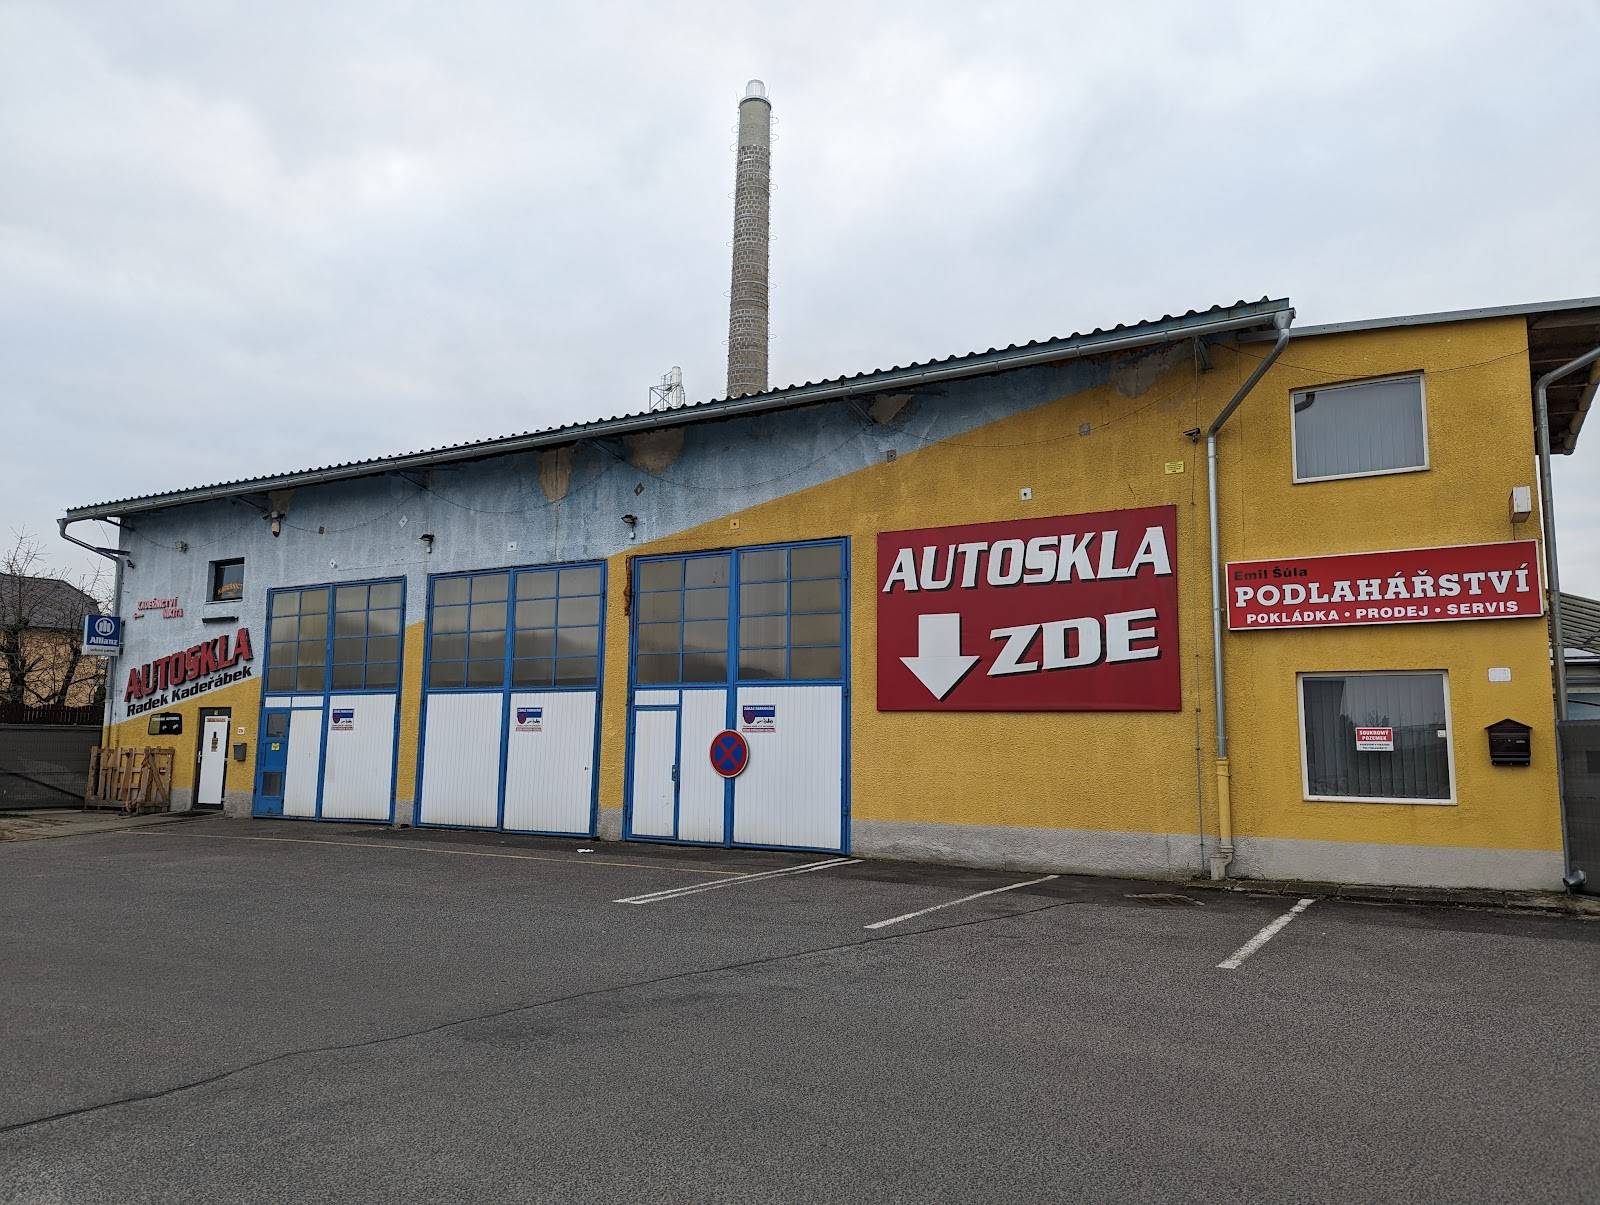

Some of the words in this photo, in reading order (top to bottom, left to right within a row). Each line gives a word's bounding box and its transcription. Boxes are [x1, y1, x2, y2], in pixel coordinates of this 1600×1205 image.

[882, 526, 1172, 593] AUTOSKLA
[1234, 570, 1268, 581] Emil
[1235, 563, 1530, 607] PODLAHÁŘSTVÍ
[1246, 610, 1339, 624] POKLÁDKA
[1356, 605, 1429, 619] PRODEJ
[1447, 601, 1519, 615] SERVIS
[89, 637, 119, 646] Allianz
[124, 628, 254, 703] AUTOSKLA
[986, 608, 1160, 677] ZDE
[127, 695, 169, 717] Radek
[172, 665, 252, 702] Kadeřábek
